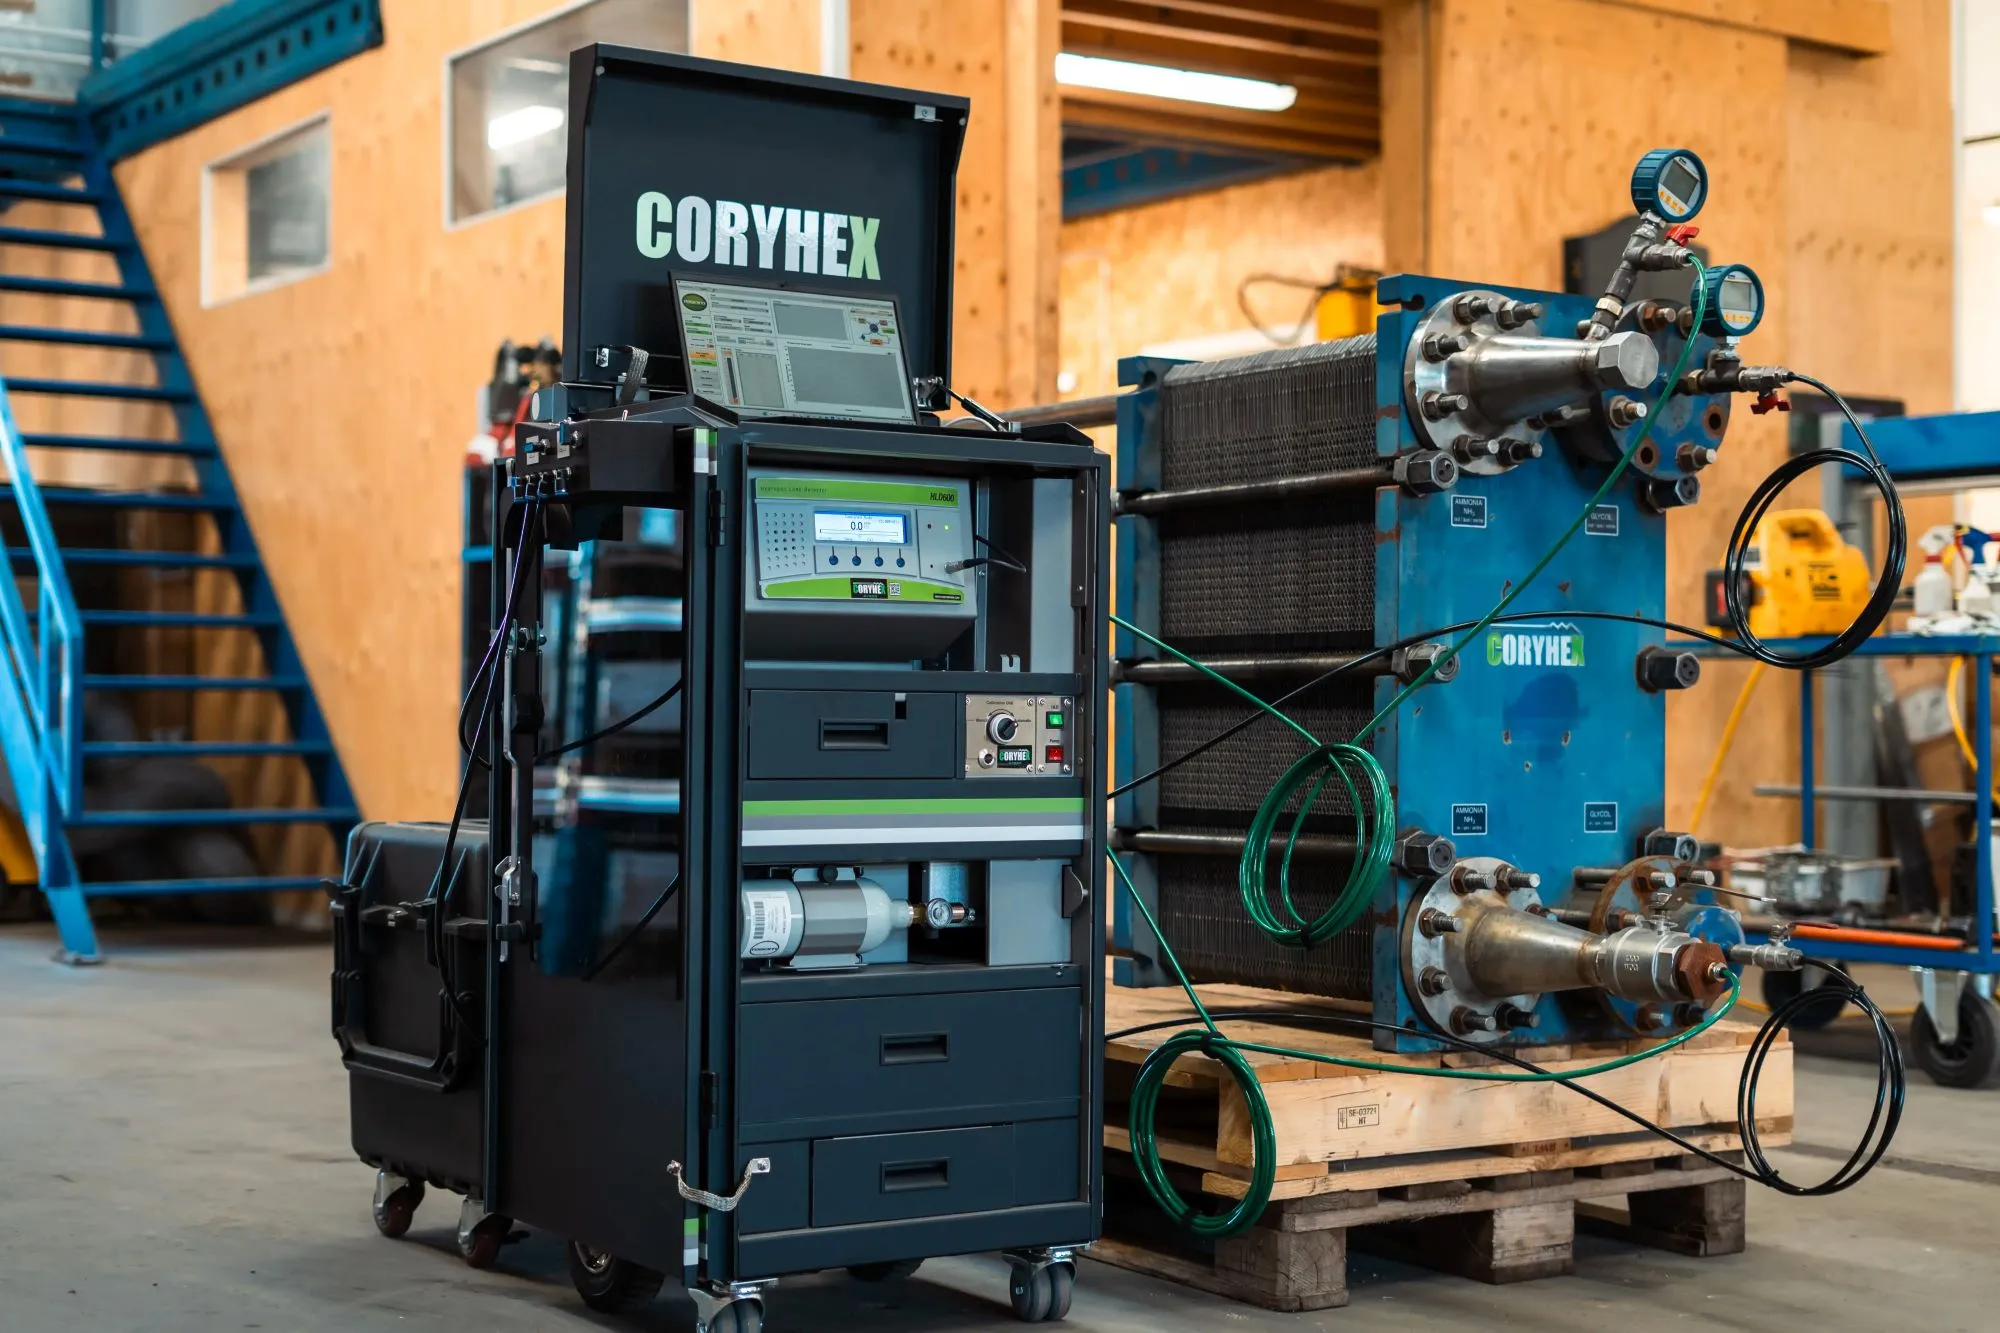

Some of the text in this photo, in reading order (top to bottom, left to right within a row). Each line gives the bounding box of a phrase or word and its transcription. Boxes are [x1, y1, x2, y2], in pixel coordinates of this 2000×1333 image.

[636, 191, 881, 280] CORYHEX
[930, 492, 955, 502] HLD600
[1454, 498, 1483, 506] AMMONIA
[1590, 512, 1613, 521] GLYCOL
[850, 521, 863, 531] 0.0
[853, 582, 886, 595] CORYHEX
[1486, 632, 1585, 667] CORYHEX
[999, 751, 1031, 762] CORYHEX
[1455, 807, 1484, 815] AMMONIA
[1589, 810, 1612, 818] GLYCOL
[1348, 1106, 1377, 1117] SE-03721
[1358, 1116, 1367, 1125] HT
